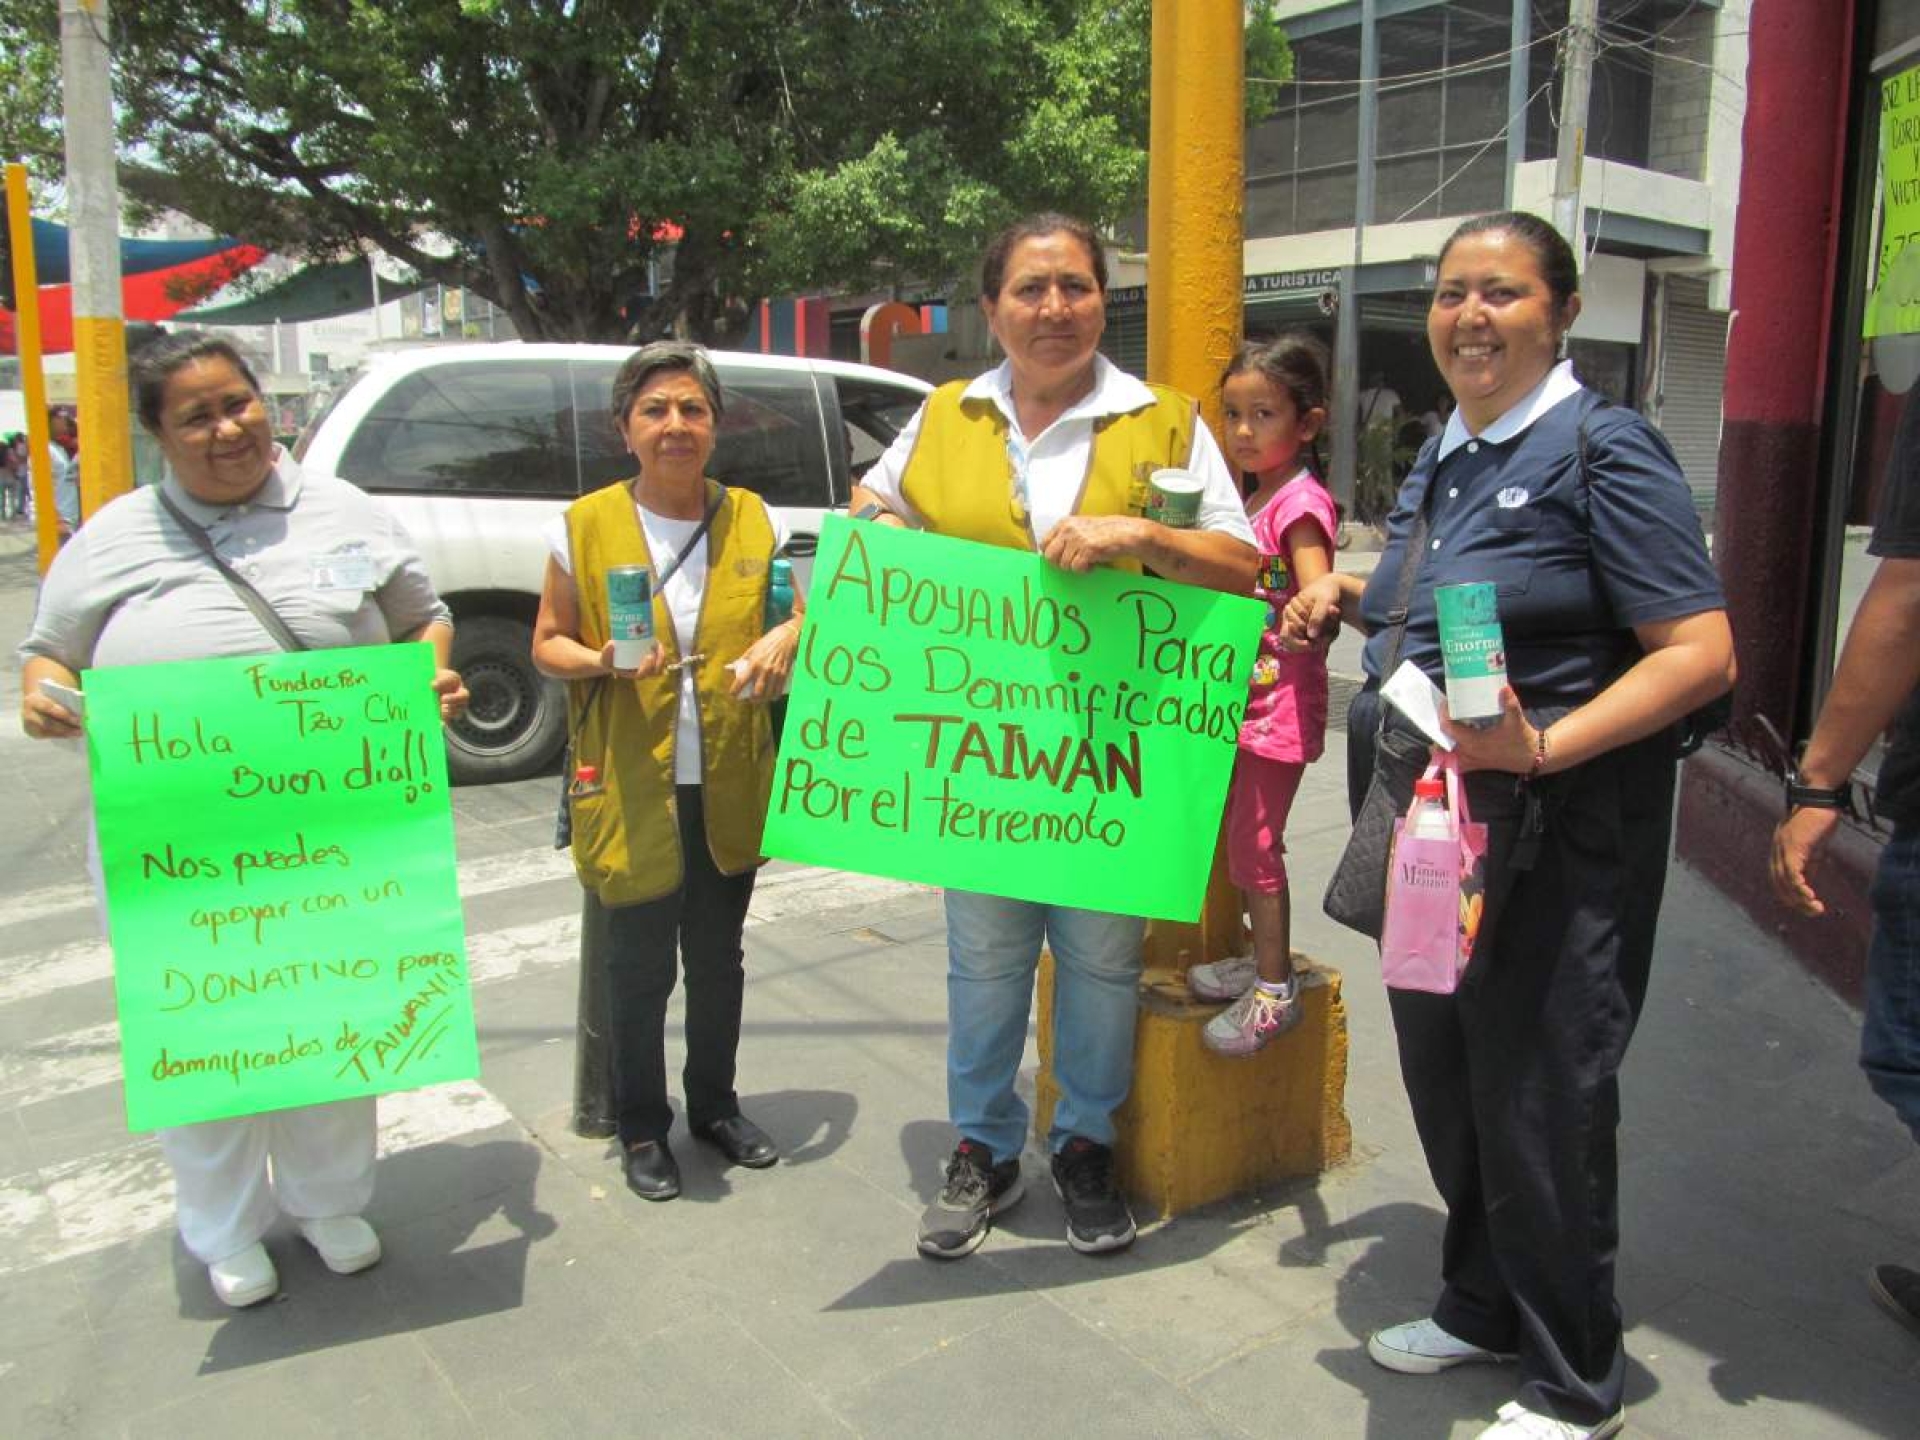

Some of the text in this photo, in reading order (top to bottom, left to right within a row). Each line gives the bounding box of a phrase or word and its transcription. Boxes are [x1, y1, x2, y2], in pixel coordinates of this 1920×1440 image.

[1891, 178, 1920, 206] VICT
[1117, 590, 1235, 683] Para
[277, 693, 408, 738] Tzu Chi
[805, 624, 1240, 744] los Damnificados
[127, 712, 232, 764] Hola
[800, 699, 1143, 798] de TAIWAN
[871, 770, 910, 833] el
[923, 777, 1126, 847] terremoto
[141, 832, 349, 885] Nos puedes
[190, 880, 402, 944] apoyar con un
[160, 952, 457, 1011] DONATIVO para
[152, 1034, 323, 1085] damnificados
[336, 1021, 360, 1051] de
